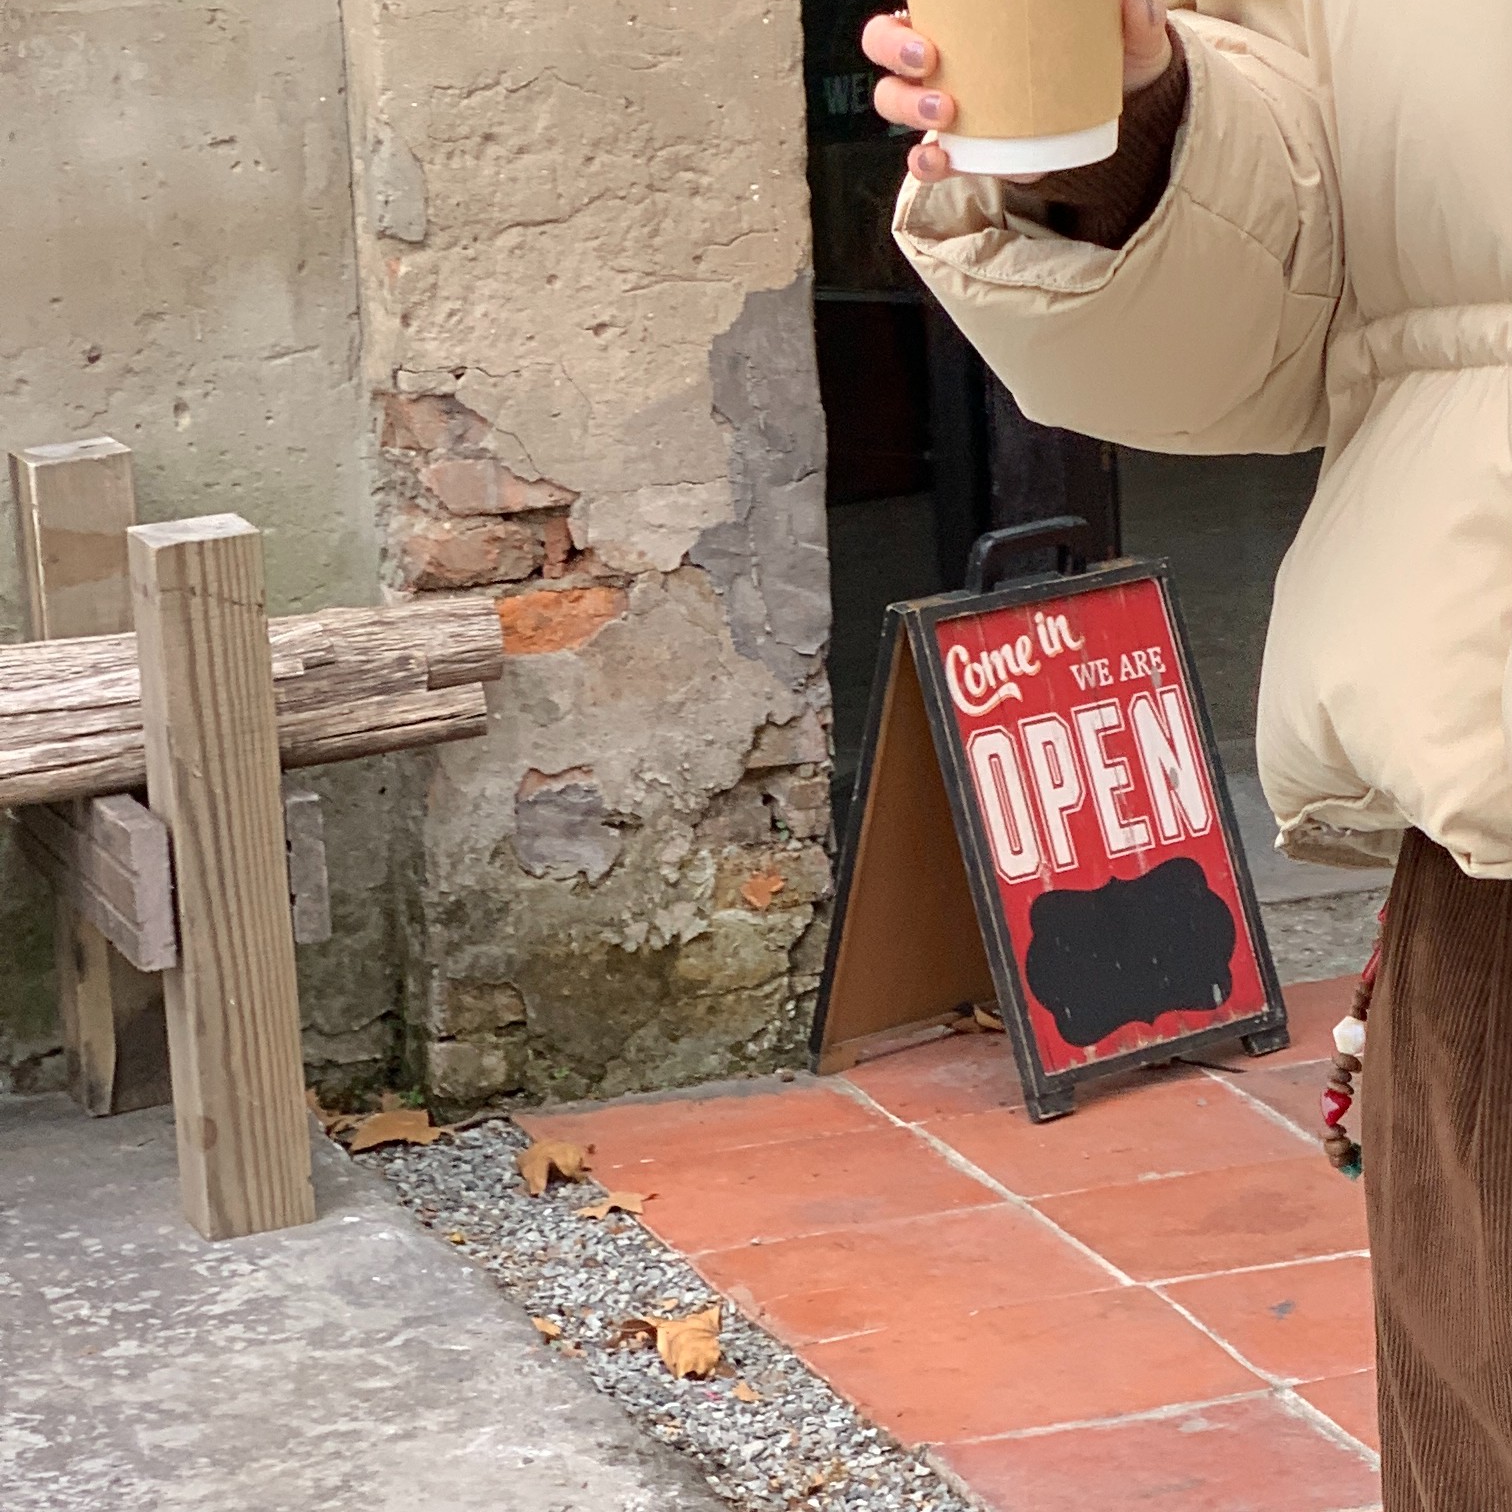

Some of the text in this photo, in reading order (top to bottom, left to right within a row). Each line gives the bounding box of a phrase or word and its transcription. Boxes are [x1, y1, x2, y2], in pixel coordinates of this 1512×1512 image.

[945, 611, 1085, 718] Come in
[1069, 646, 1167, 692] WE ARE
[966, 684, 1213, 886] OPEN
